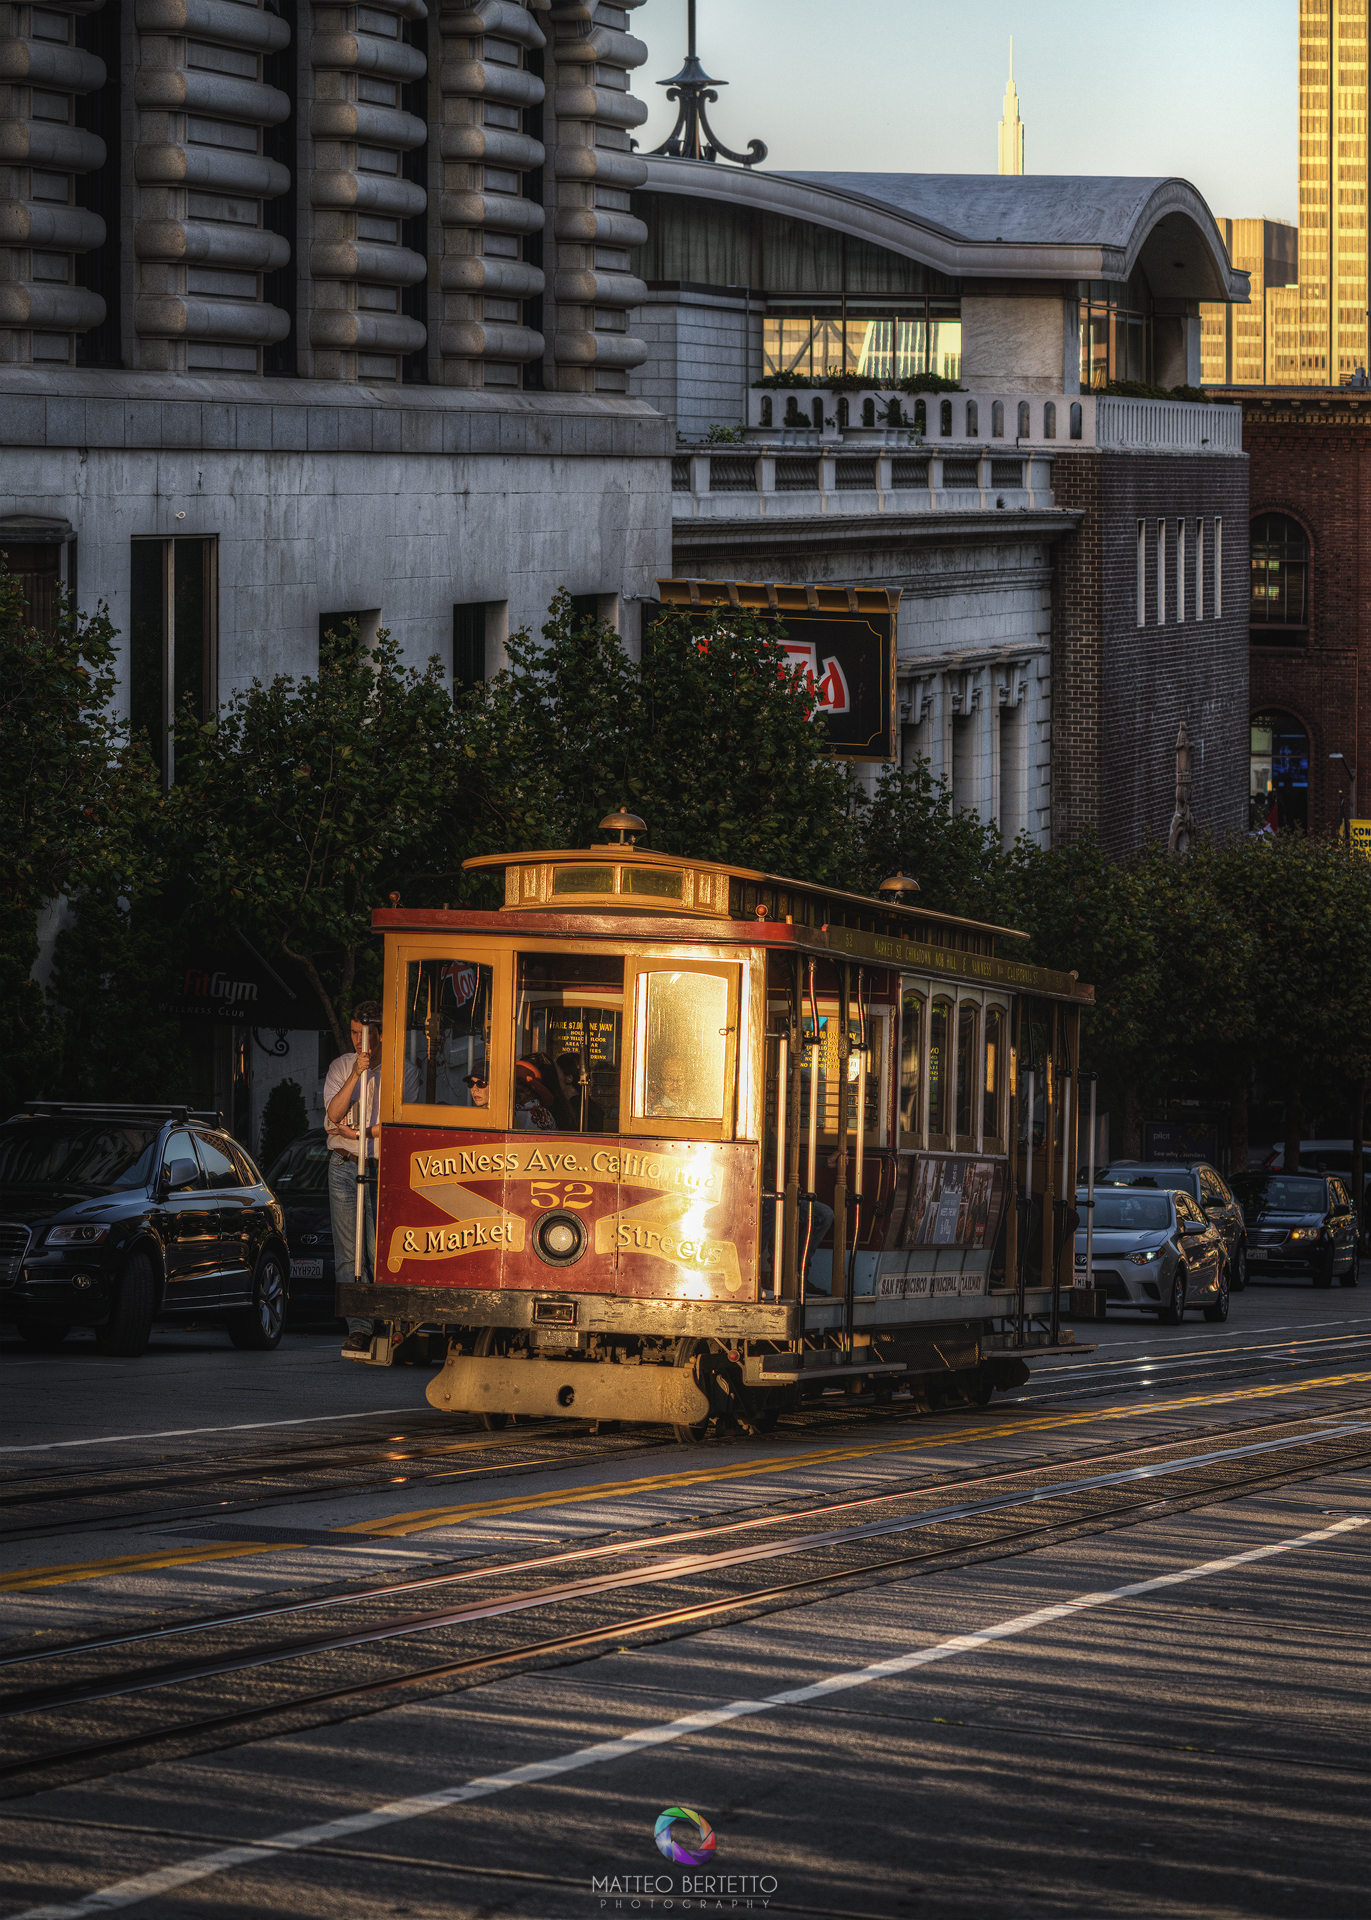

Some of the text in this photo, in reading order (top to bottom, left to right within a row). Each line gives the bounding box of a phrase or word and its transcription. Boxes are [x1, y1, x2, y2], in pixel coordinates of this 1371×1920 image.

[845, 933, 853, 948] 52
[874, 940, 893, 958] MARKET
[905, 946, 930, 965] CHINATOWN
[935, 952, 944, 967] NOB
[946, 954, 956, 970] HILL
[1007, 966, 1032, 983] CALIFORNIA
[1153, 1131, 1171, 1141] pilot
[415, 1155, 458, 1179] Van
[459, 1151, 520, 1175] Ness
[1166, 1150, 1179, 1158] why
[530, 1181, 594, 1210] 52
[402, 1221, 723, 1266] & Market Streets
[881, 1278, 895, 1296] SAN
[895, 1276, 928, 1295] FRANCISCO
[929, 1275, 957, 1293] MUNICIPAL
